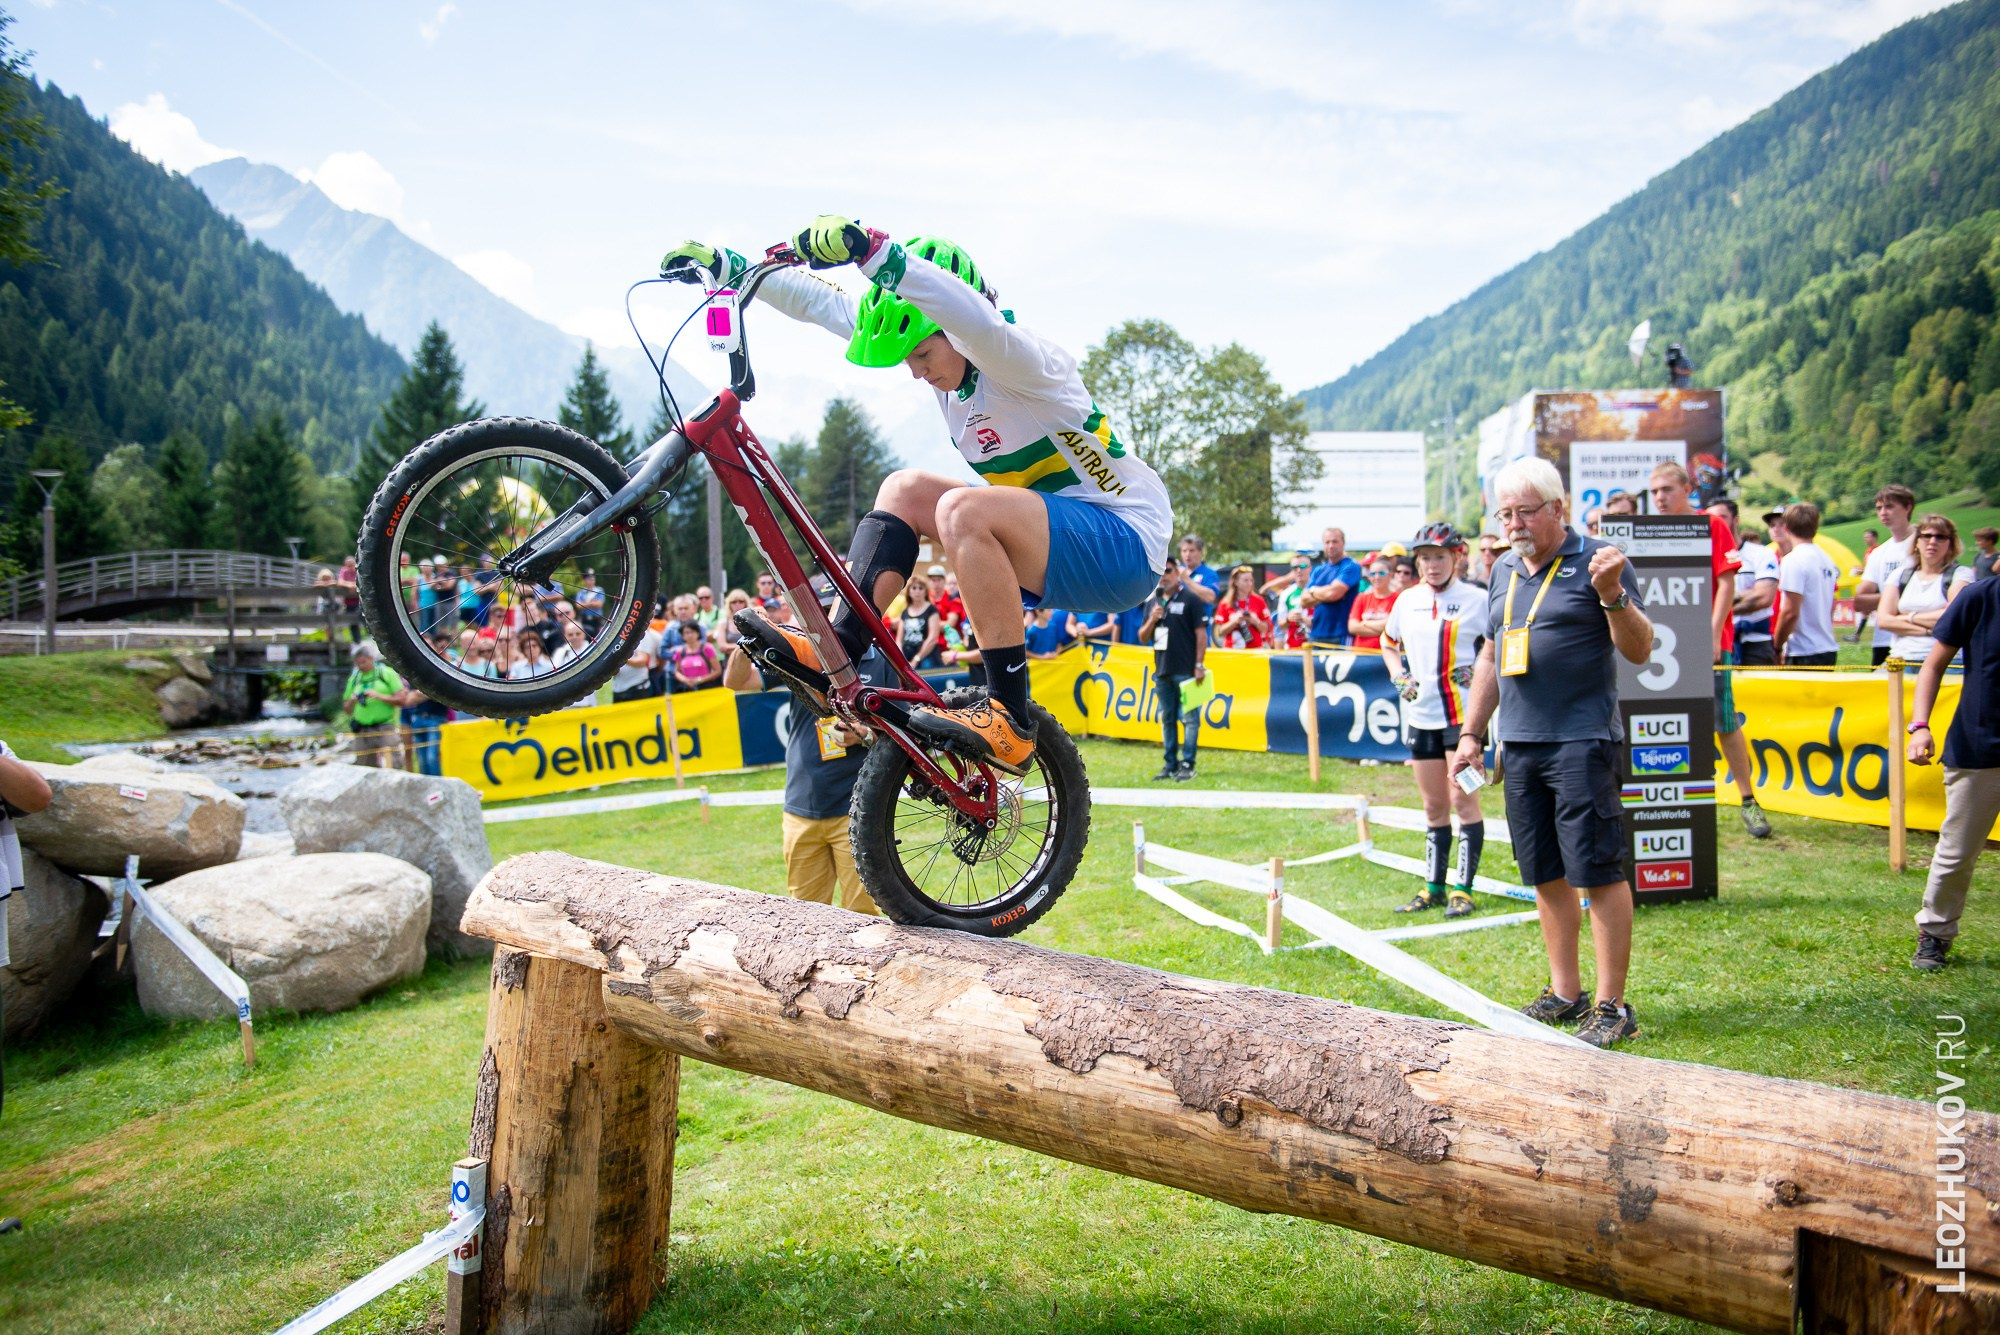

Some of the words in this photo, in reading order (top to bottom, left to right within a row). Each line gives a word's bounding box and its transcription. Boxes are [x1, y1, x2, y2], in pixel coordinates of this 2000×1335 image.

[1605, 526, 1630, 537] UCI
[1637, 623, 1680, 692] 3
[1646, 721, 1681, 736] UCI
[483, 713, 702, 785] Melinda
[1645, 787, 1679, 802] UCI
[1633, 809, 1691, 821] #TrialsWorlds
[1650, 835, 1684, 852] UCI
